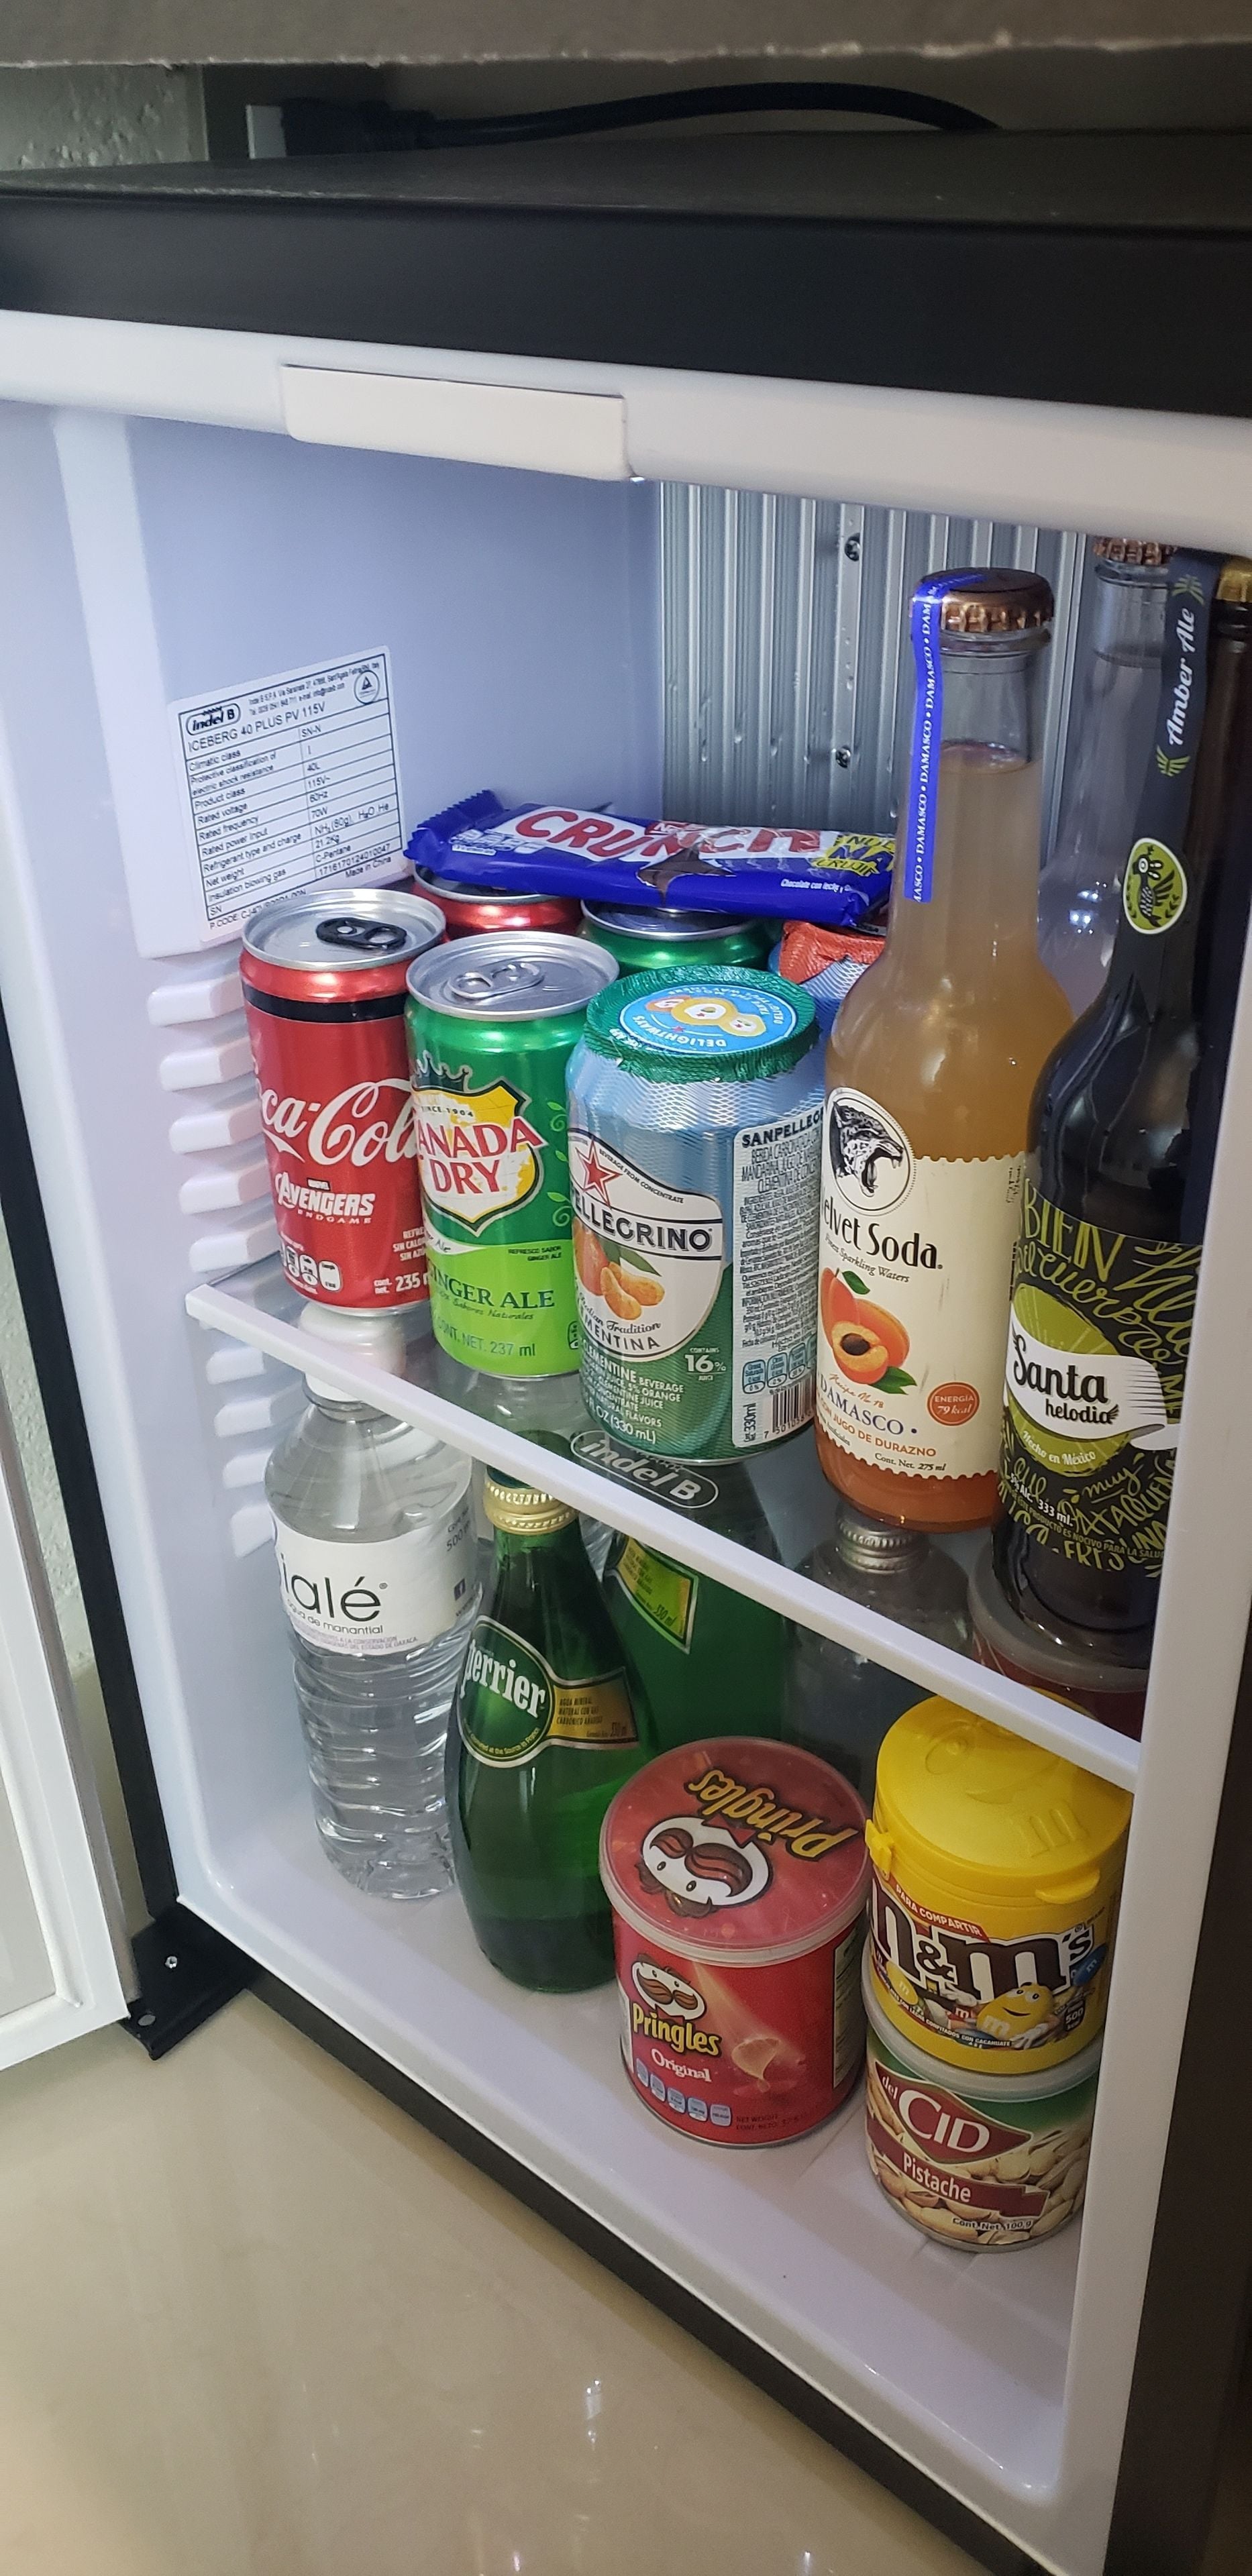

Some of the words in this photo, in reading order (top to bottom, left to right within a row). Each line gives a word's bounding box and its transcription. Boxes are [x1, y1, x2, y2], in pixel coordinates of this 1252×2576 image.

[1174, 607, 1195, 653] Ale
[925, 647, 934, 709] DAMASCO
[1167, 657, 1195, 746] Amber
[188, 728, 238, 753] ICEBERG
[241, 724, 254, 736] 40
[256, 715, 283, 733] PLUS
[286, 708, 299, 723] PV
[303, 700, 326, 718] 115V
[302, 724, 322, 738] SN-N
[190, 755, 220, 771] Climatic
[221, 750, 241, 761] class
[921, 719, 933, 783] DAMASCO
[191, 768, 225, 784] Protective
[225, 756, 269, 773] classification
[193, 782, 217, 796] electric
[219, 775, 239, 788] shock
[240, 765, 274, 782] resistance
[195, 794, 225, 808] Product
[225, 788, 246, 800] class
[309, 791, 329, 803] 60Hz
[197, 811, 221, 824] Rated
[221, 802, 248, 818] voltage
[311, 807, 328, 819] 70W
[915, 793, 928, 855] DAMASCO
[199, 826, 222, 840] Rated
[223, 816, 259, 834] frequency
[202, 845, 225, 857] Rated
[225, 837, 248, 851] power
[249, 828, 268, 842] input
[203, 854, 244, 873] Refrigerant
[245, 847, 261, 859] type
[262, 841, 276, 851] and
[276, 833, 302, 847] charge
[315, 845, 351, 863] C-Pentane
[206, 876, 220, 888] Net
[221, 867, 246, 883] weight
[345, 867, 364, 877] Made
[373, 857, 392, 869] China
[209, 886, 243, 902] Insulation
[244, 873, 272, 889] blowing
[272, 868, 286, 881] gas
[780, 879, 809, 890] Chocolate
[810, 882, 823, 890] con
[209, 905, 222, 916] SN
[631, 1014, 727, 1049] DELIGHTWAYS
[446, 1107, 474, 1118] 1904
[431, 1159, 500, 1195] DRY
[598, 1148, 624, 1171] BEVERAGE
[623, 1168, 640, 1184] FROM
[639, 1181, 684, 1204] CONCENTRATE
[274, 1171, 376, 1217] AVENGERS
[297, 1209, 372, 1224] ENDGAME
[393, 1242, 405, 1252] SIN
[400, 1252, 412, 1261] SIN
[508, 1246, 539, 1254] REFRESCO
[527, 1253, 550, 1261] GINGER
[839, 1248, 876, 1277] Sparkling
[878, 1265, 910, 1283] Waters
[395, 1273, 421, 1292] 235
[453, 1298, 483, 1316] Sabores
[487, 1309, 535, 1320] Naturales
[500, 1289, 556, 1309] ALE
[606, 1320, 661, 1335] Tradition
[490, 1341, 514, 1356] 237
[519, 1343, 536, 1356] ml
[583, 1339, 637, 1383] CLEMENTINE
[638, 1376, 684, 1393] BEVERAGE
[684, 1354, 727, 1373] 16%
[1012, 1329, 1110, 1404] Santa
[598, 1375, 639, 1403] CLEMENTINE
[640, 1397, 664, 1409] JUICE
[627, 1382, 640, 1394] 5%
[641, 1387, 681, 1402] ORANGE
[820, 1373, 904, 1436] DAMASCO
[934, 1393, 975, 1403] ENERGÍA
[625, 1409, 662, 1428] FLAVORS
[743, 1403, 757, 1432] 330ml
[937, 1405, 949, 1415] 79
[950, 1404, 972, 1415] kcal
[1045, 1397, 1117, 1426] helodia
[595, 1405, 609, 1422] OZ
[610, 1415, 633, 1436] (330
[635, 1430, 656, 1445] mL)
[833, 1412, 855, 1434] JUGO
[857, 1430, 872, 1444] DE
[874, 1437, 937, 1457] DURAZNO
[1021, 1430, 1047, 1458] Hecho
[1048, 1454, 1061, 1464] en
[1061, 1450, 1096, 1465] México
[580, 1438, 679, 1487] indel
[669, 1479, 701, 1500] B
[874, 1452, 896, 1466] Cont.
[898, 1459, 915, 1469] Net.
[917, 1462, 934, 1471] 275
[935, 1463, 947, 1472] ml
[1037, 1499, 1055, 1517] 333
[1056, 1511, 1074, 1527] ml.
[446, 1529, 464, 1552] 500
[1028, 1506, 1062, 1534] PRODUCTO
[1062, 1527, 1072, 1538] ES
[1073, 1532, 1102, 1549] NOCIVO
[1103, 1542, 1125, 1555] PARA
[1127, 1547, 1137, 1556] LA
[307, 1615, 321, 1627] de
[323, 1621, 383, 1635] manantial
[654, 1604, 668, 1621] 330
[504, 1743, 522, 1755] Source
[688, 1768, 859, 1858] Pringles
[896, 1884, 918, 1915] PARA
[919, 1907, 983, 1937] COMPARTIR
[1065, 2007, 1084, 2025] 500
[632, 2002, 722, 2057] Pringles
[926, 2019, 960, 2039] CONFITADOS
[961, 2033, 974, 2042] CON
[975, 2038, 1010, 2047] CACAHUATE
[651, 2048, 712, 2083] Original
[882, 2076, 898, 2101] del
[898, 2088, 990, 2153] CID
[902, 2151, 972, 2204] Pistache
[951, 2217, 980, 2229] Cont.
[1005, 2220, 1023, 2230] 100
